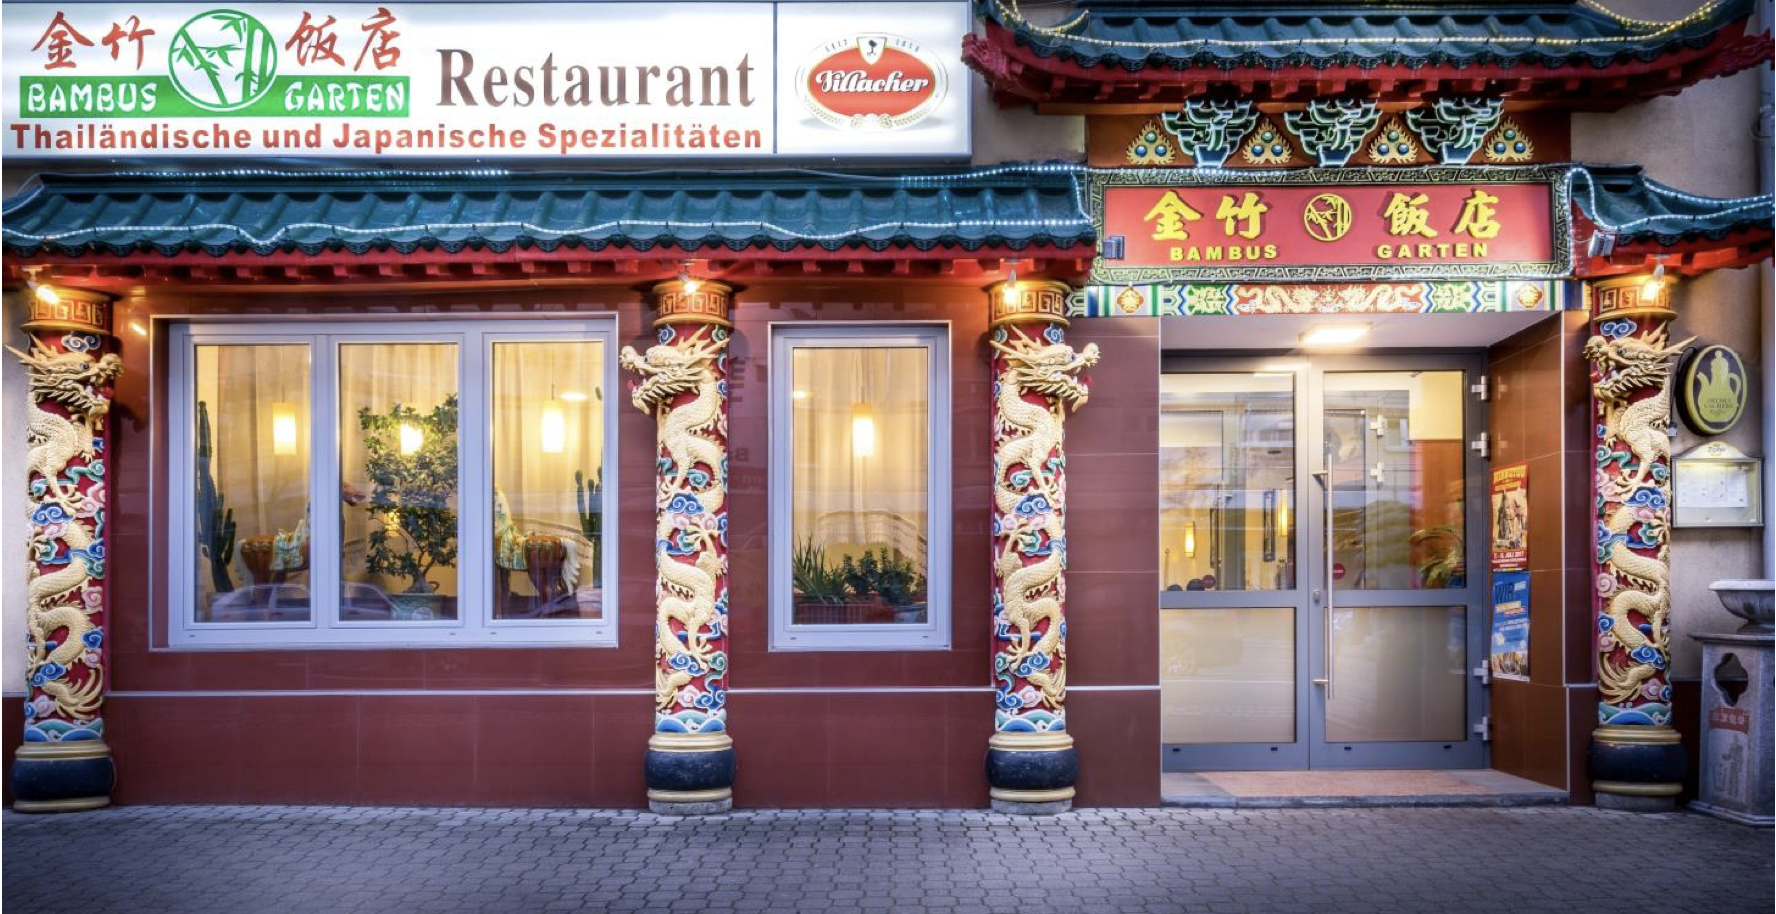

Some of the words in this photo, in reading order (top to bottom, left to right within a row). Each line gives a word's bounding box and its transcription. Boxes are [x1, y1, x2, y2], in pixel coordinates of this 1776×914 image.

[31, 11, 155, 70] 金竹
[436, 48, 755, 108] Restaurant
[815, 69, 929, 93] Villacher
[27, 82, 157, 112] BAMBUS
[284, 82, 404, 111] GARTEN
[11, 123, 252, 149] Thailändische
[262, 123, 321, 149] und
[333, 123, 527, 154] Japanische
[538, 122, 762, 154] Spezialitäten
[1144, 189, 1268, 242] 金竹
[1169, 244, 1278, 261] BAMBUS
[1377, 243, 1488, 259] GARTEN
